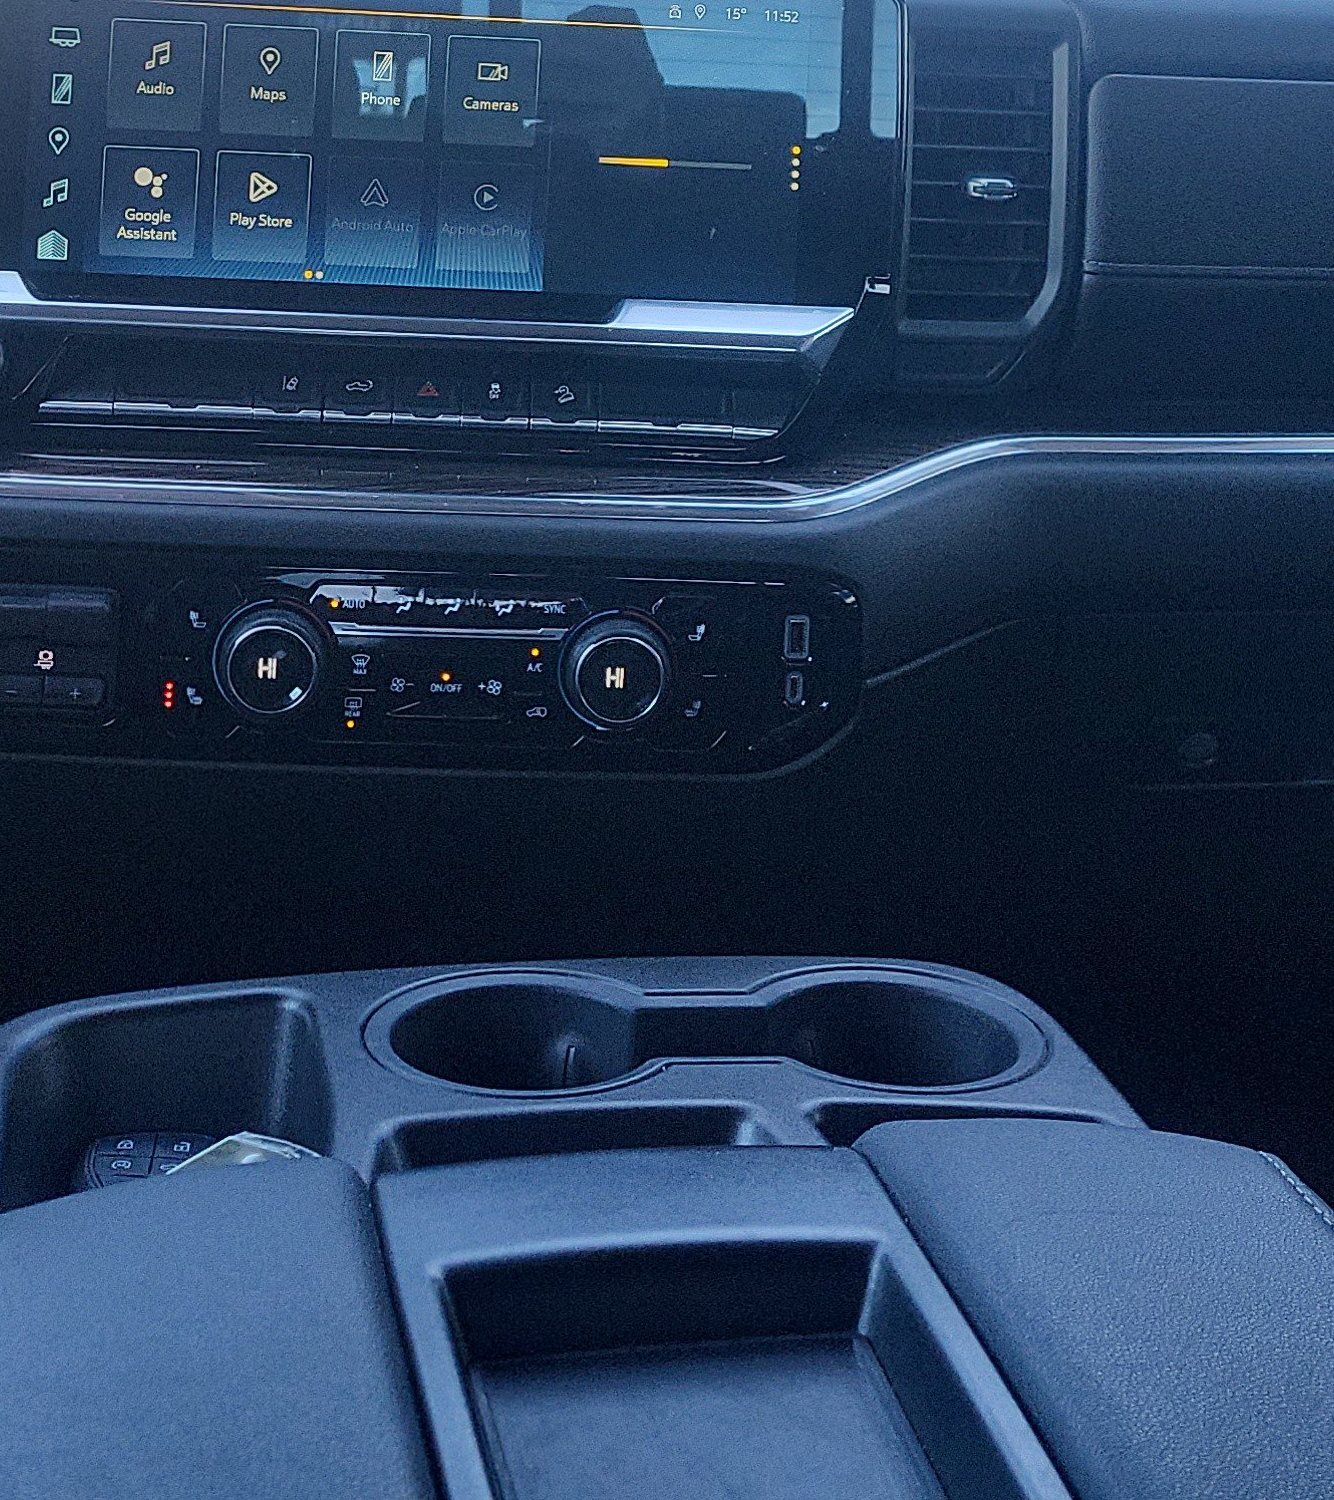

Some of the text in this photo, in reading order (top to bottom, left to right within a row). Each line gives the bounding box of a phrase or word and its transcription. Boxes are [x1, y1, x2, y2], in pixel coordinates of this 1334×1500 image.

[725, 6, 800, 23] 15° 11:52
[136, 81, 175, 97] Audio
[250, 87, 287, 103] Maps
[360, 91, 402, 108] Phone
[462, 96, 520, 112] Cameras
[124, 207, 172, 225] Google
[229, 212, 293, 230] Play Store
[331, 216, 415, 233] Android Auto
[116, 225, 178, 242] Assistant
[440, 221, 528, 241] Apple CarPlay
[342, 598, 366, 610] AUTO
[543, 604, 566, 615] SYNC
[256, 657, 278, 680] HI
[526, 662, 544, 673] A/C
[605, 666, 626, 689] HI
[429, 682, 463, 694] ON/OFF
